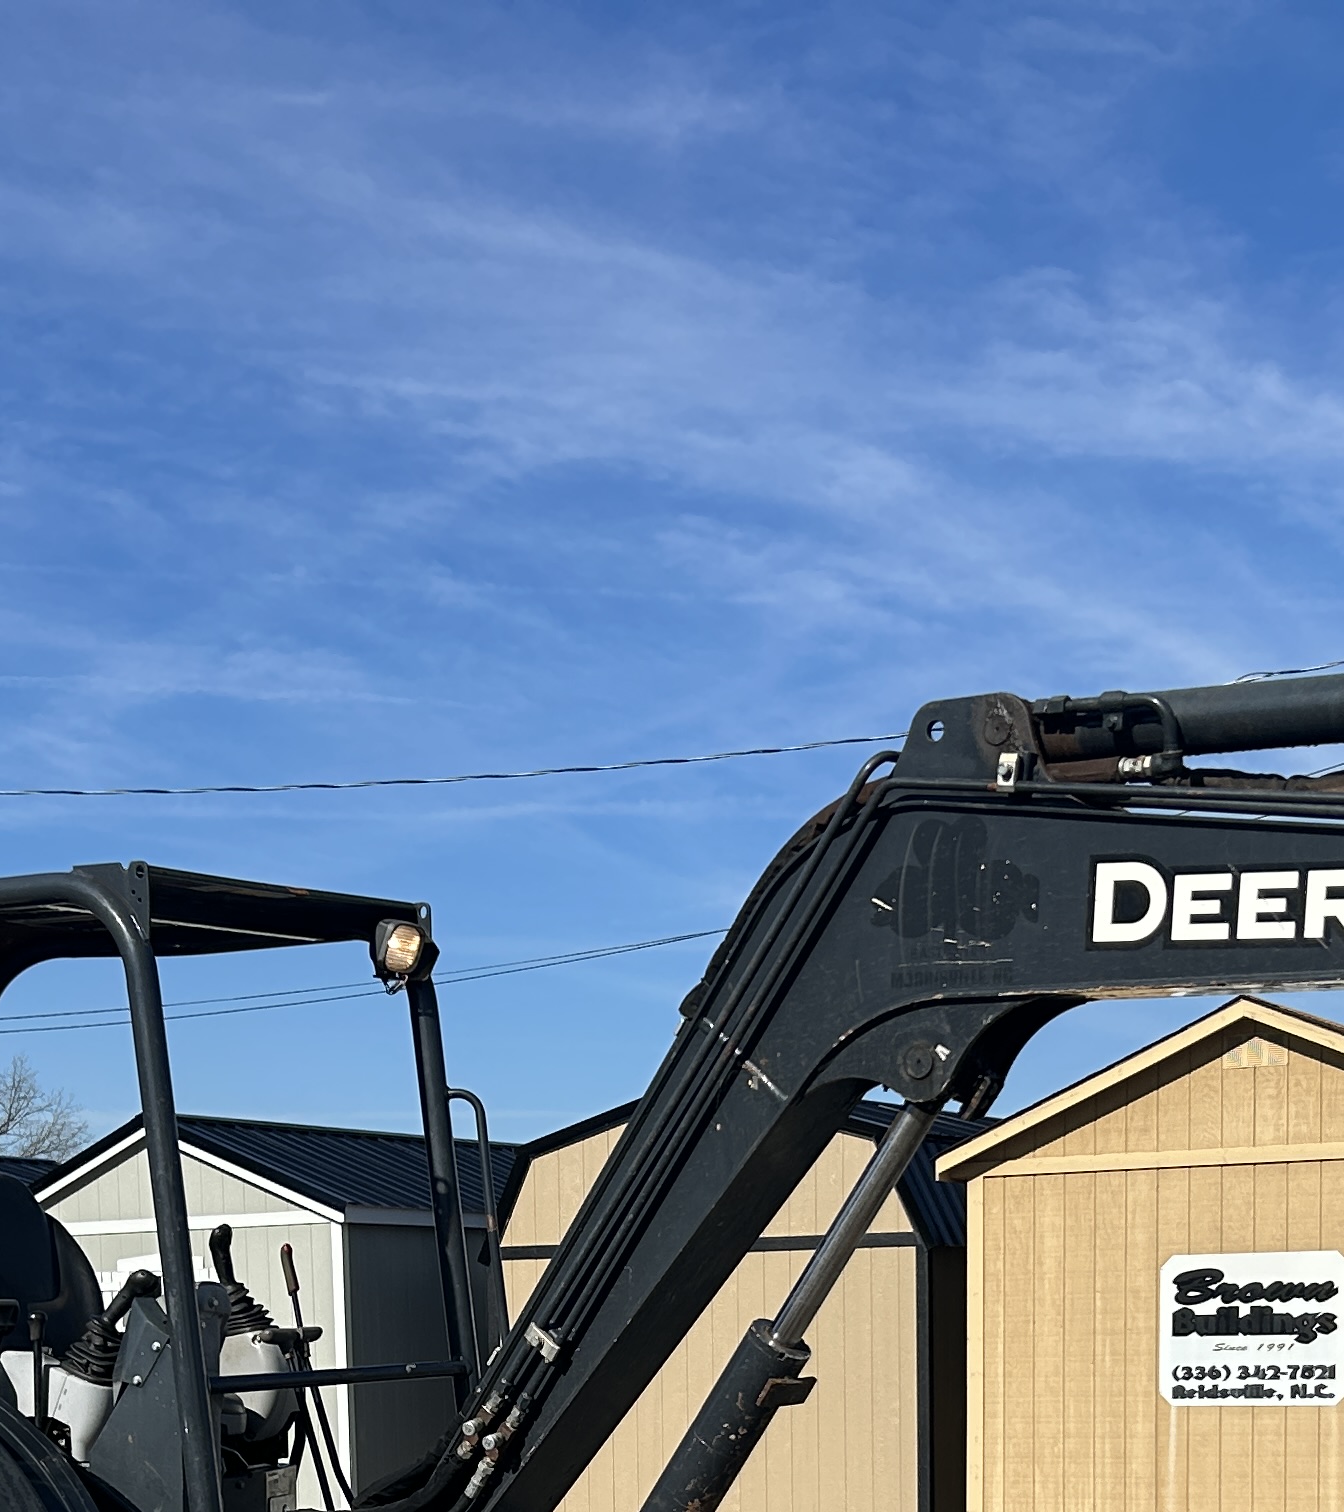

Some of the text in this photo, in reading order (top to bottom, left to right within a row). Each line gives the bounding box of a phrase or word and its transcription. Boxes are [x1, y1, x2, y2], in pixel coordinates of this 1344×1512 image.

[1172, 1268, 1339, 1305] Brown
[1172, 1306, 1338, 1344] Buildings
[1212, 1343, 1295, 1351] Since 1991
[1172, 1365, 1231, 1381] (336)
[1290, 1384, 1335, 1399] N.C.
